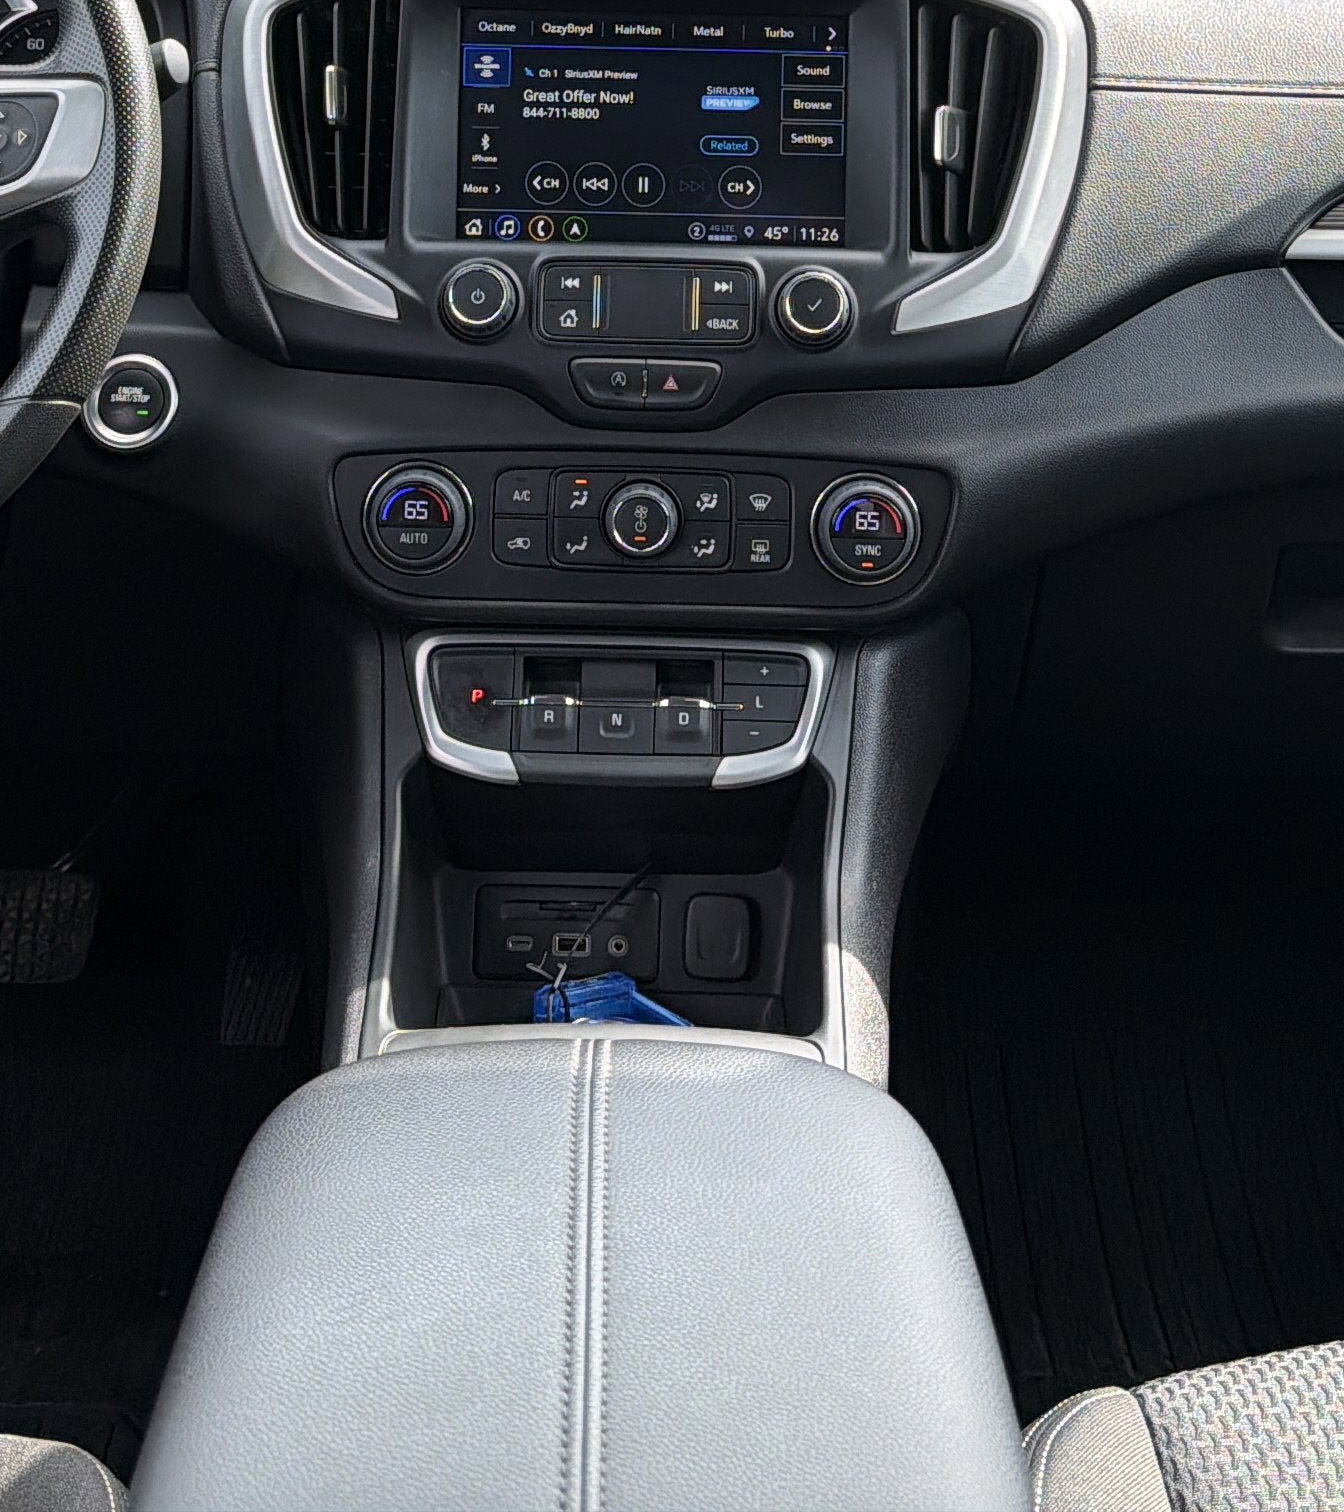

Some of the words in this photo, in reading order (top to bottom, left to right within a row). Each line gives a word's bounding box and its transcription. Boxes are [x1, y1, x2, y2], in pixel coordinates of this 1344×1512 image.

[478, 20, 517, 33] Octane
[541, 21, 594, 37] OzzyBnyd
[614, 23, 662, 38] HairNatn
[693, 25, 724, 38] Metal
[764, 27, 795, 39] Turbo
[26, 38, 45, 51] 60
[538, 68, 552, 79] Ch
[564, 69, 603, 80] SiriusXM
[604, 69, 639, 80] Preview
[797, 64, 831, 77] Sound
[523, 89, 560, 103] Great
[562, 89, 597, 103] Offer
[599, 90, 635, 104] Now!
[706, 85, 755, 96] SIRIUSXM
[477, 103, 495, 114] FM
[706, 98, 751, 108] PREVIEW
[793, 98, 833, 111] Browse
[522, 107, 600, 119] 844-711-8800
[710, 139, 749, 151] Related
[790, 132, 834, 147] Settings
[472, 154, 498, 164] iPhone
[462, 183, 489, 196] More
[543, 177, 560, 190] CH
[727, 181, 744, 194] CH
[709, 224, 721, 233] 4G
[721, 224, 735, 233] LTE
[763, 225, 789, 240] 45°
[800, 227, 839, 242] 11:26
[712, 317, 740, 332] BACK
[118, 386, 144, 395] ENGINE
[110, 393, 151, 403] START/STOP
[513, 489, 531, 503] A/C
[403, 500, 429, 520] 65
[855, 512, 880, 531] 65
[399, 532, 429, 546] AUTO
[855, 544, 883, 558] SYNC
[750, 553, 771, 563] REAR
[471, 688, 484, 704] P
[755, 695, 764, 708] L
[543, 710, 555, 724] R
[611, 713, 623, 727] N
[678, 712, 690, 726] D
